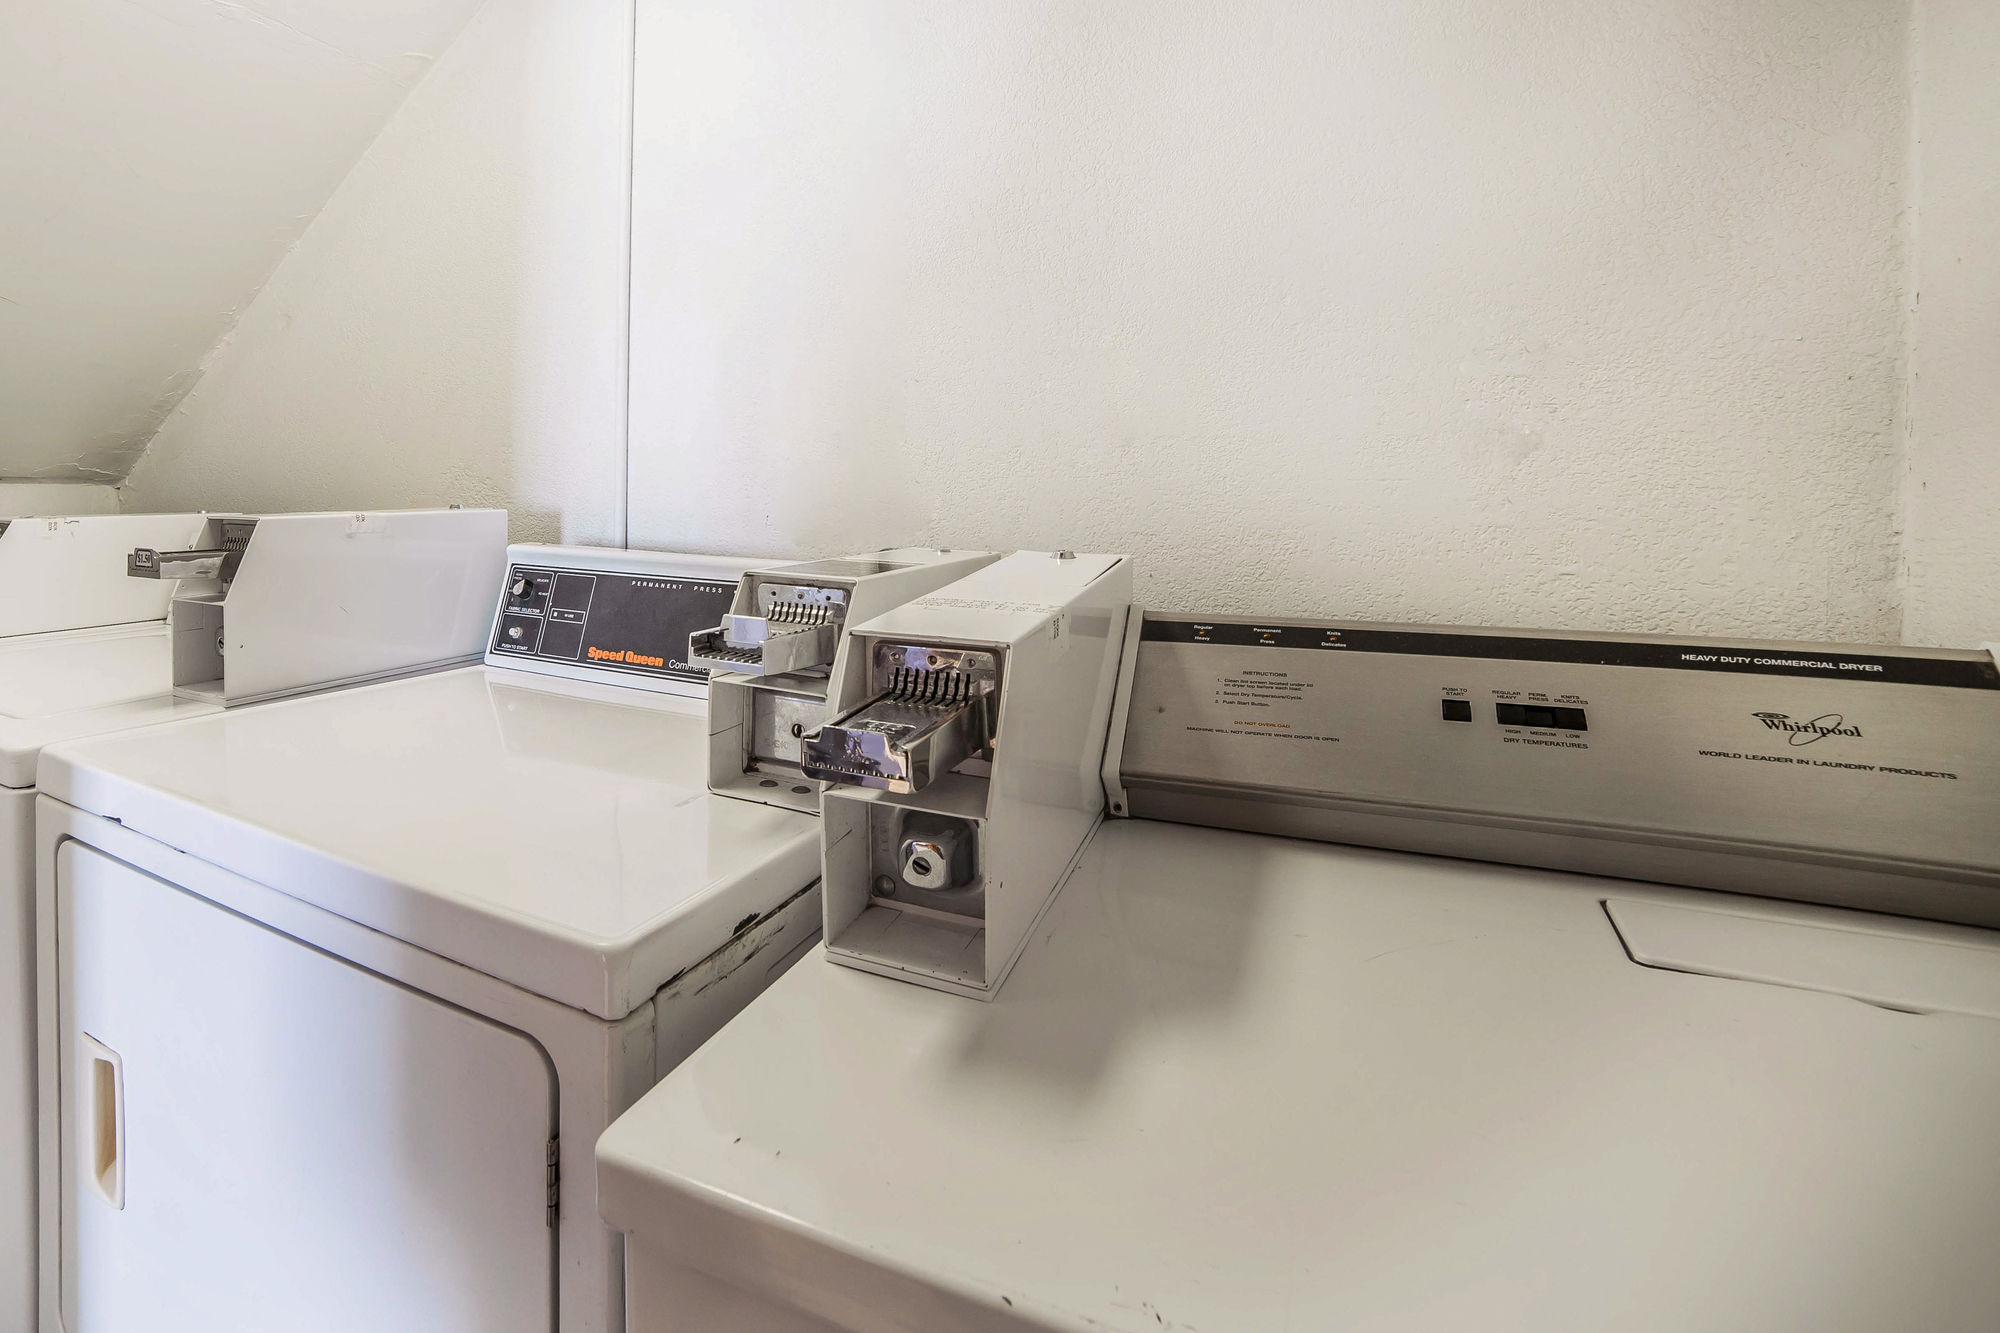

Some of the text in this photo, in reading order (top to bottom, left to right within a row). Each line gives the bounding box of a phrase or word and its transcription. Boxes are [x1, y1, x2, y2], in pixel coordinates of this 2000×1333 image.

[632, 581, 723, 594] PERMANENT PRESS
[588, 646, 625, 661] Speed
[625, 650, 664, 667] Queen
[1681, 654, 1883, 672] HEAVY DUTY COMMERCIAL DRYER
[1761, 718, 1864, 739] Whirlpool
[1522, 738, 1589, 750] TEMPERATURES
[1699, 750, 1958, 780] WORLD LEADER IN LAUNDRY PRODUCTS
